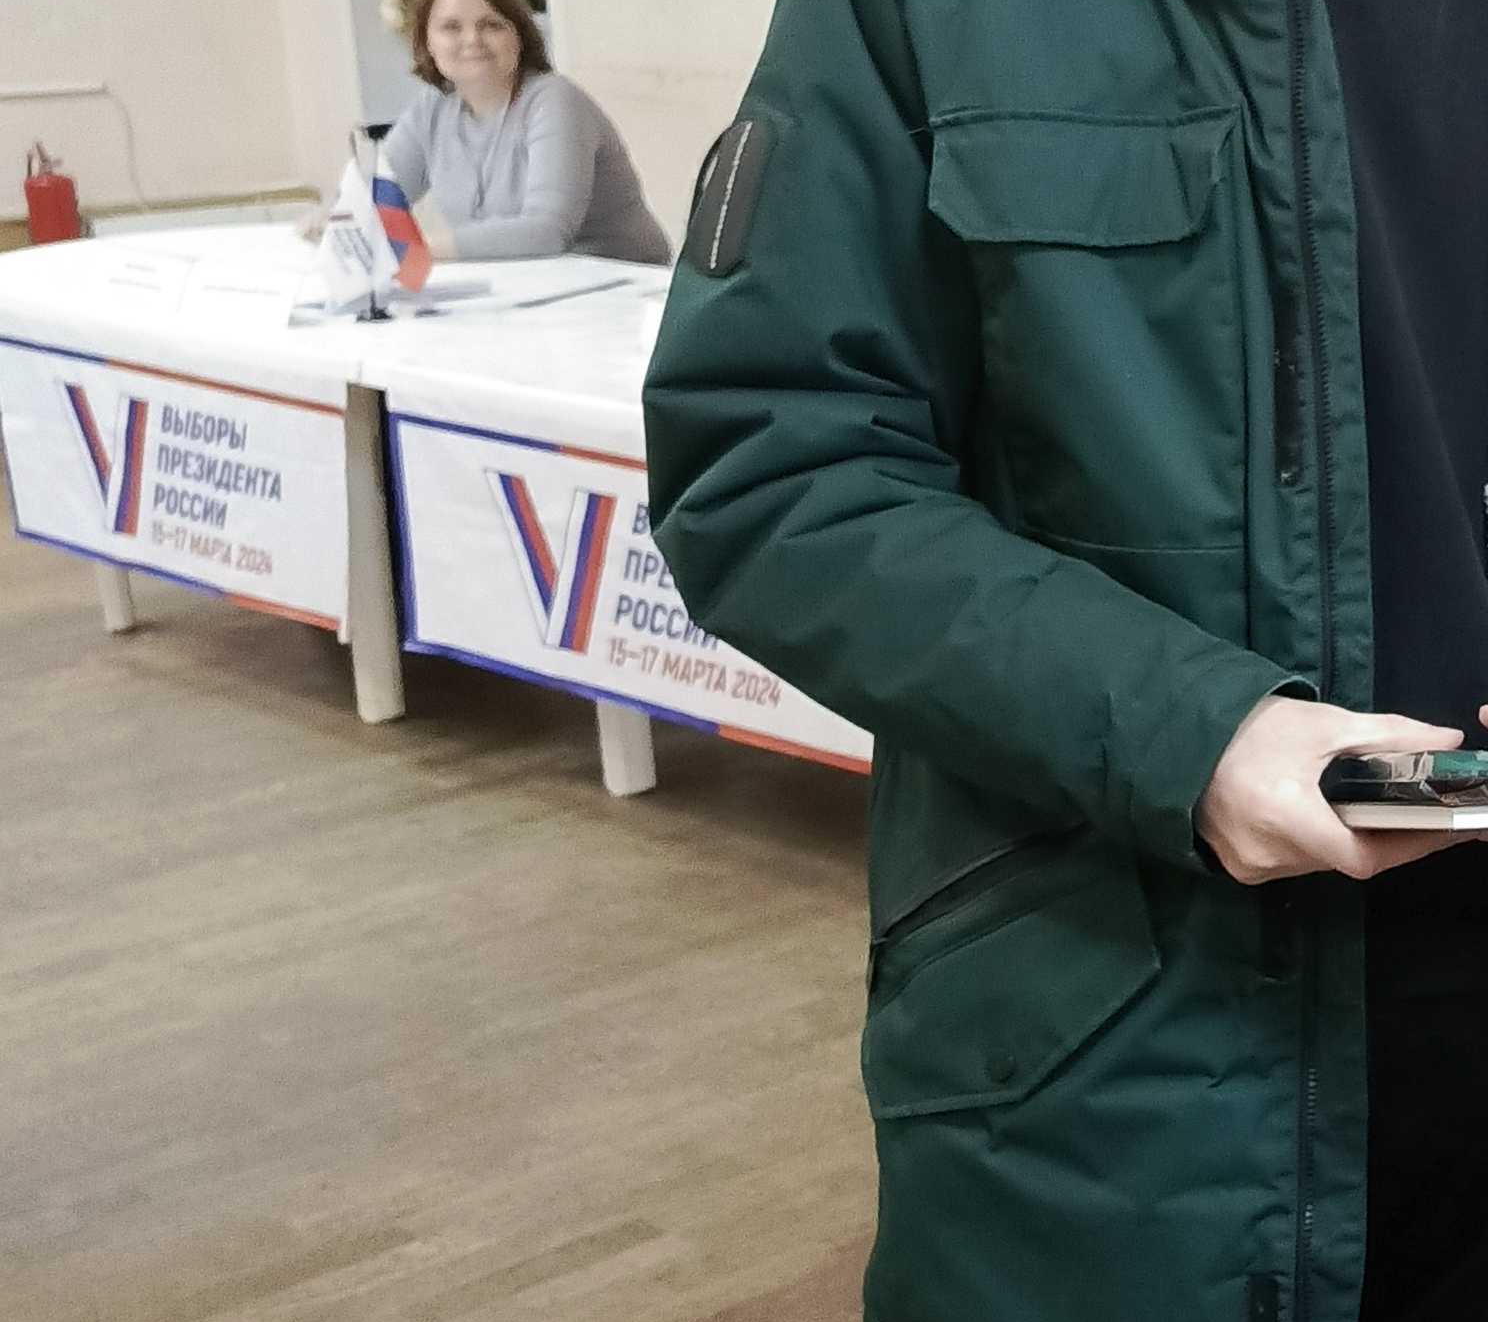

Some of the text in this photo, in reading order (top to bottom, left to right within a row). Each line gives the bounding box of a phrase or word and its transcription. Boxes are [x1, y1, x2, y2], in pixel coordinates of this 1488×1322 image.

[160, 403, 248, 452] ВЫБОРЫ
[156, 443, 282, 503] ПРЕЗИДЕНТА
[153, 482, 229, 530] РОССИИ
[609, 637, 782, 708] 15–17 МАРТА 2024
